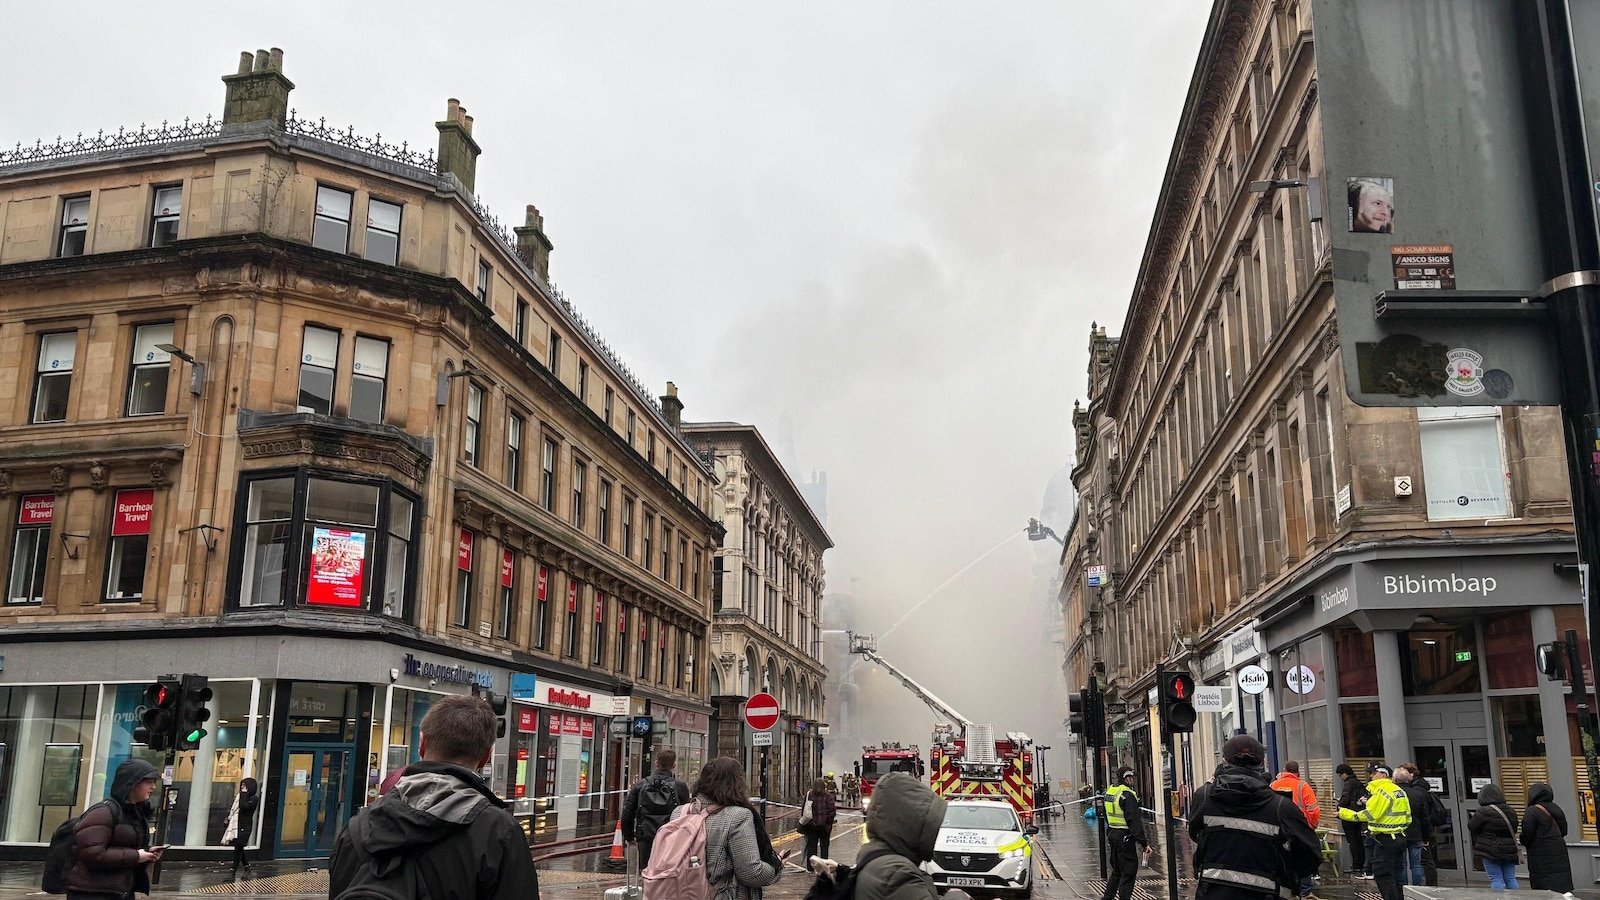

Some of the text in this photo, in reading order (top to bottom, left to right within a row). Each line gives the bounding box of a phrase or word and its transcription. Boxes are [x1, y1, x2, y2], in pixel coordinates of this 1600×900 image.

[30, 509, 52, 519] Travel
[125, 512, 148, 522] Travel
[1383, 573, 1497, 597] Bibimbap
[1320, 586, 1349, 612] Bibimbap
[1241, 673, 1265, 683] Asahi
[1196, 692, 1220, 700] Pastéis
[949, 878, 982, 887] MT23 XPK
